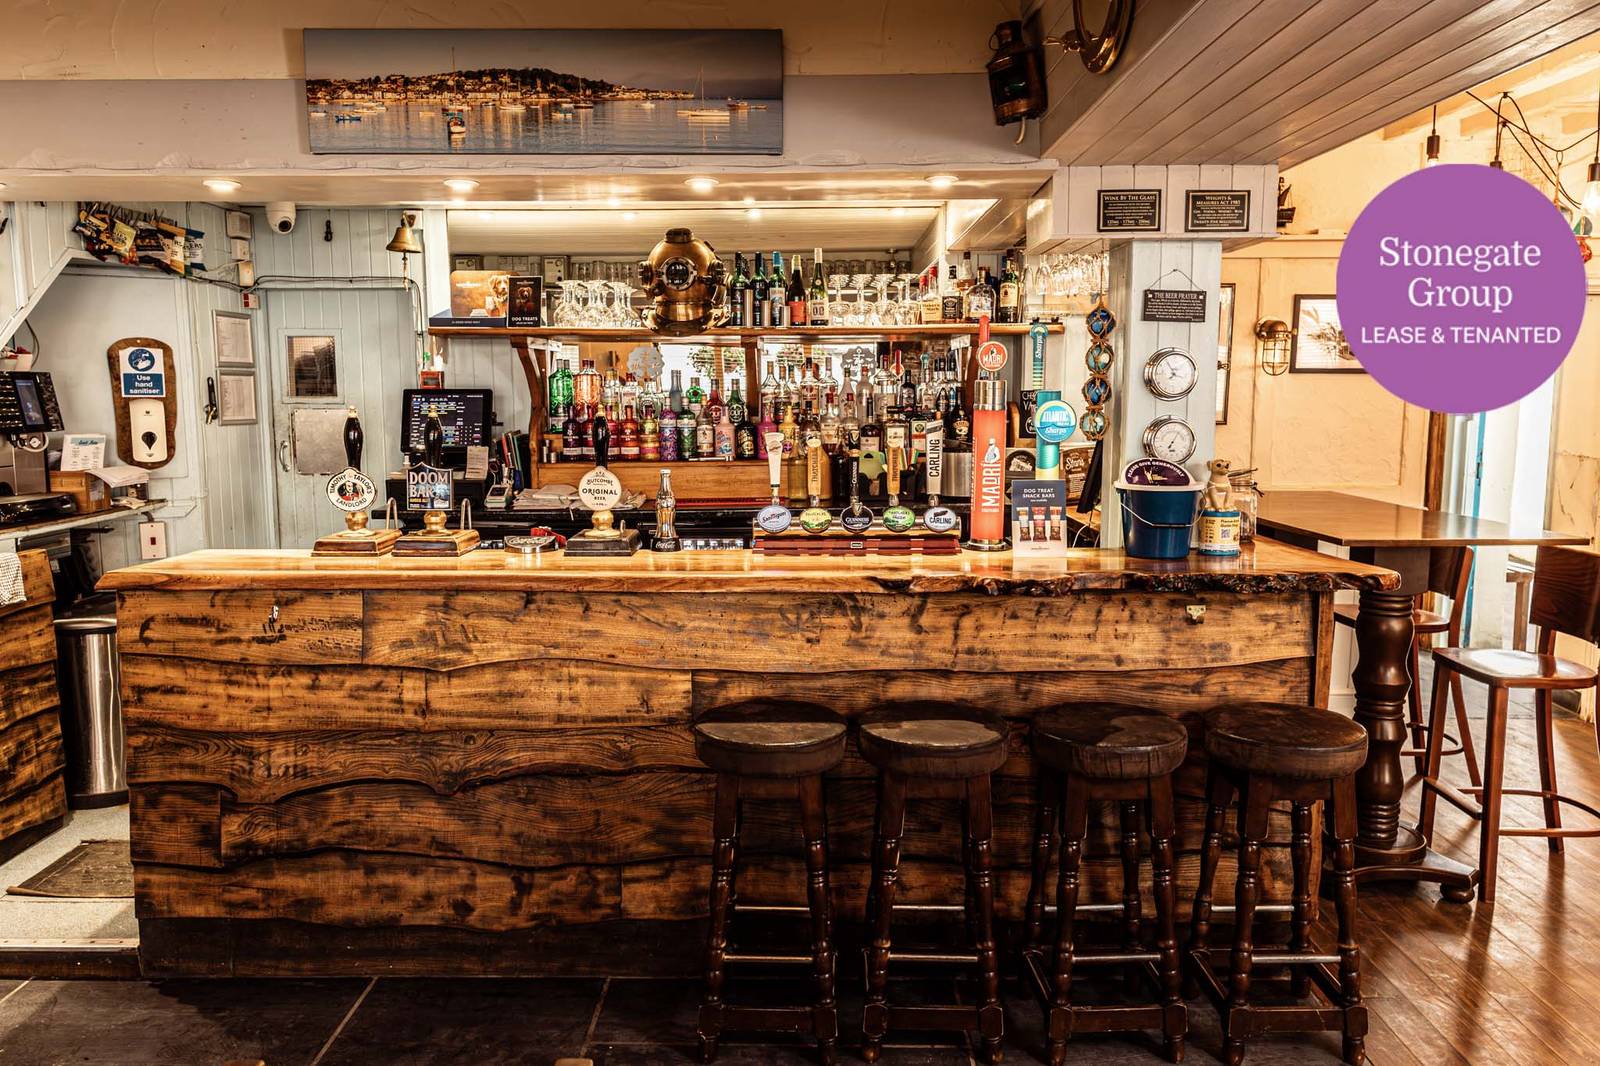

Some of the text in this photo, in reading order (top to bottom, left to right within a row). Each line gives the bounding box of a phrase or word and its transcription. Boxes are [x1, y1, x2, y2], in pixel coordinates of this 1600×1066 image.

[929, 439, 940, 478] CARLING
[329, 474, 347, 494] TIMOTHY
[409, 471, 449, 485] DOOM
[409, 484, 435, 498] BAR
[582, 488, 619, 496] ORIGINAL
[335, 497, 368, 508] LANDLORD
[929, 516, 953, 525] CARLING
